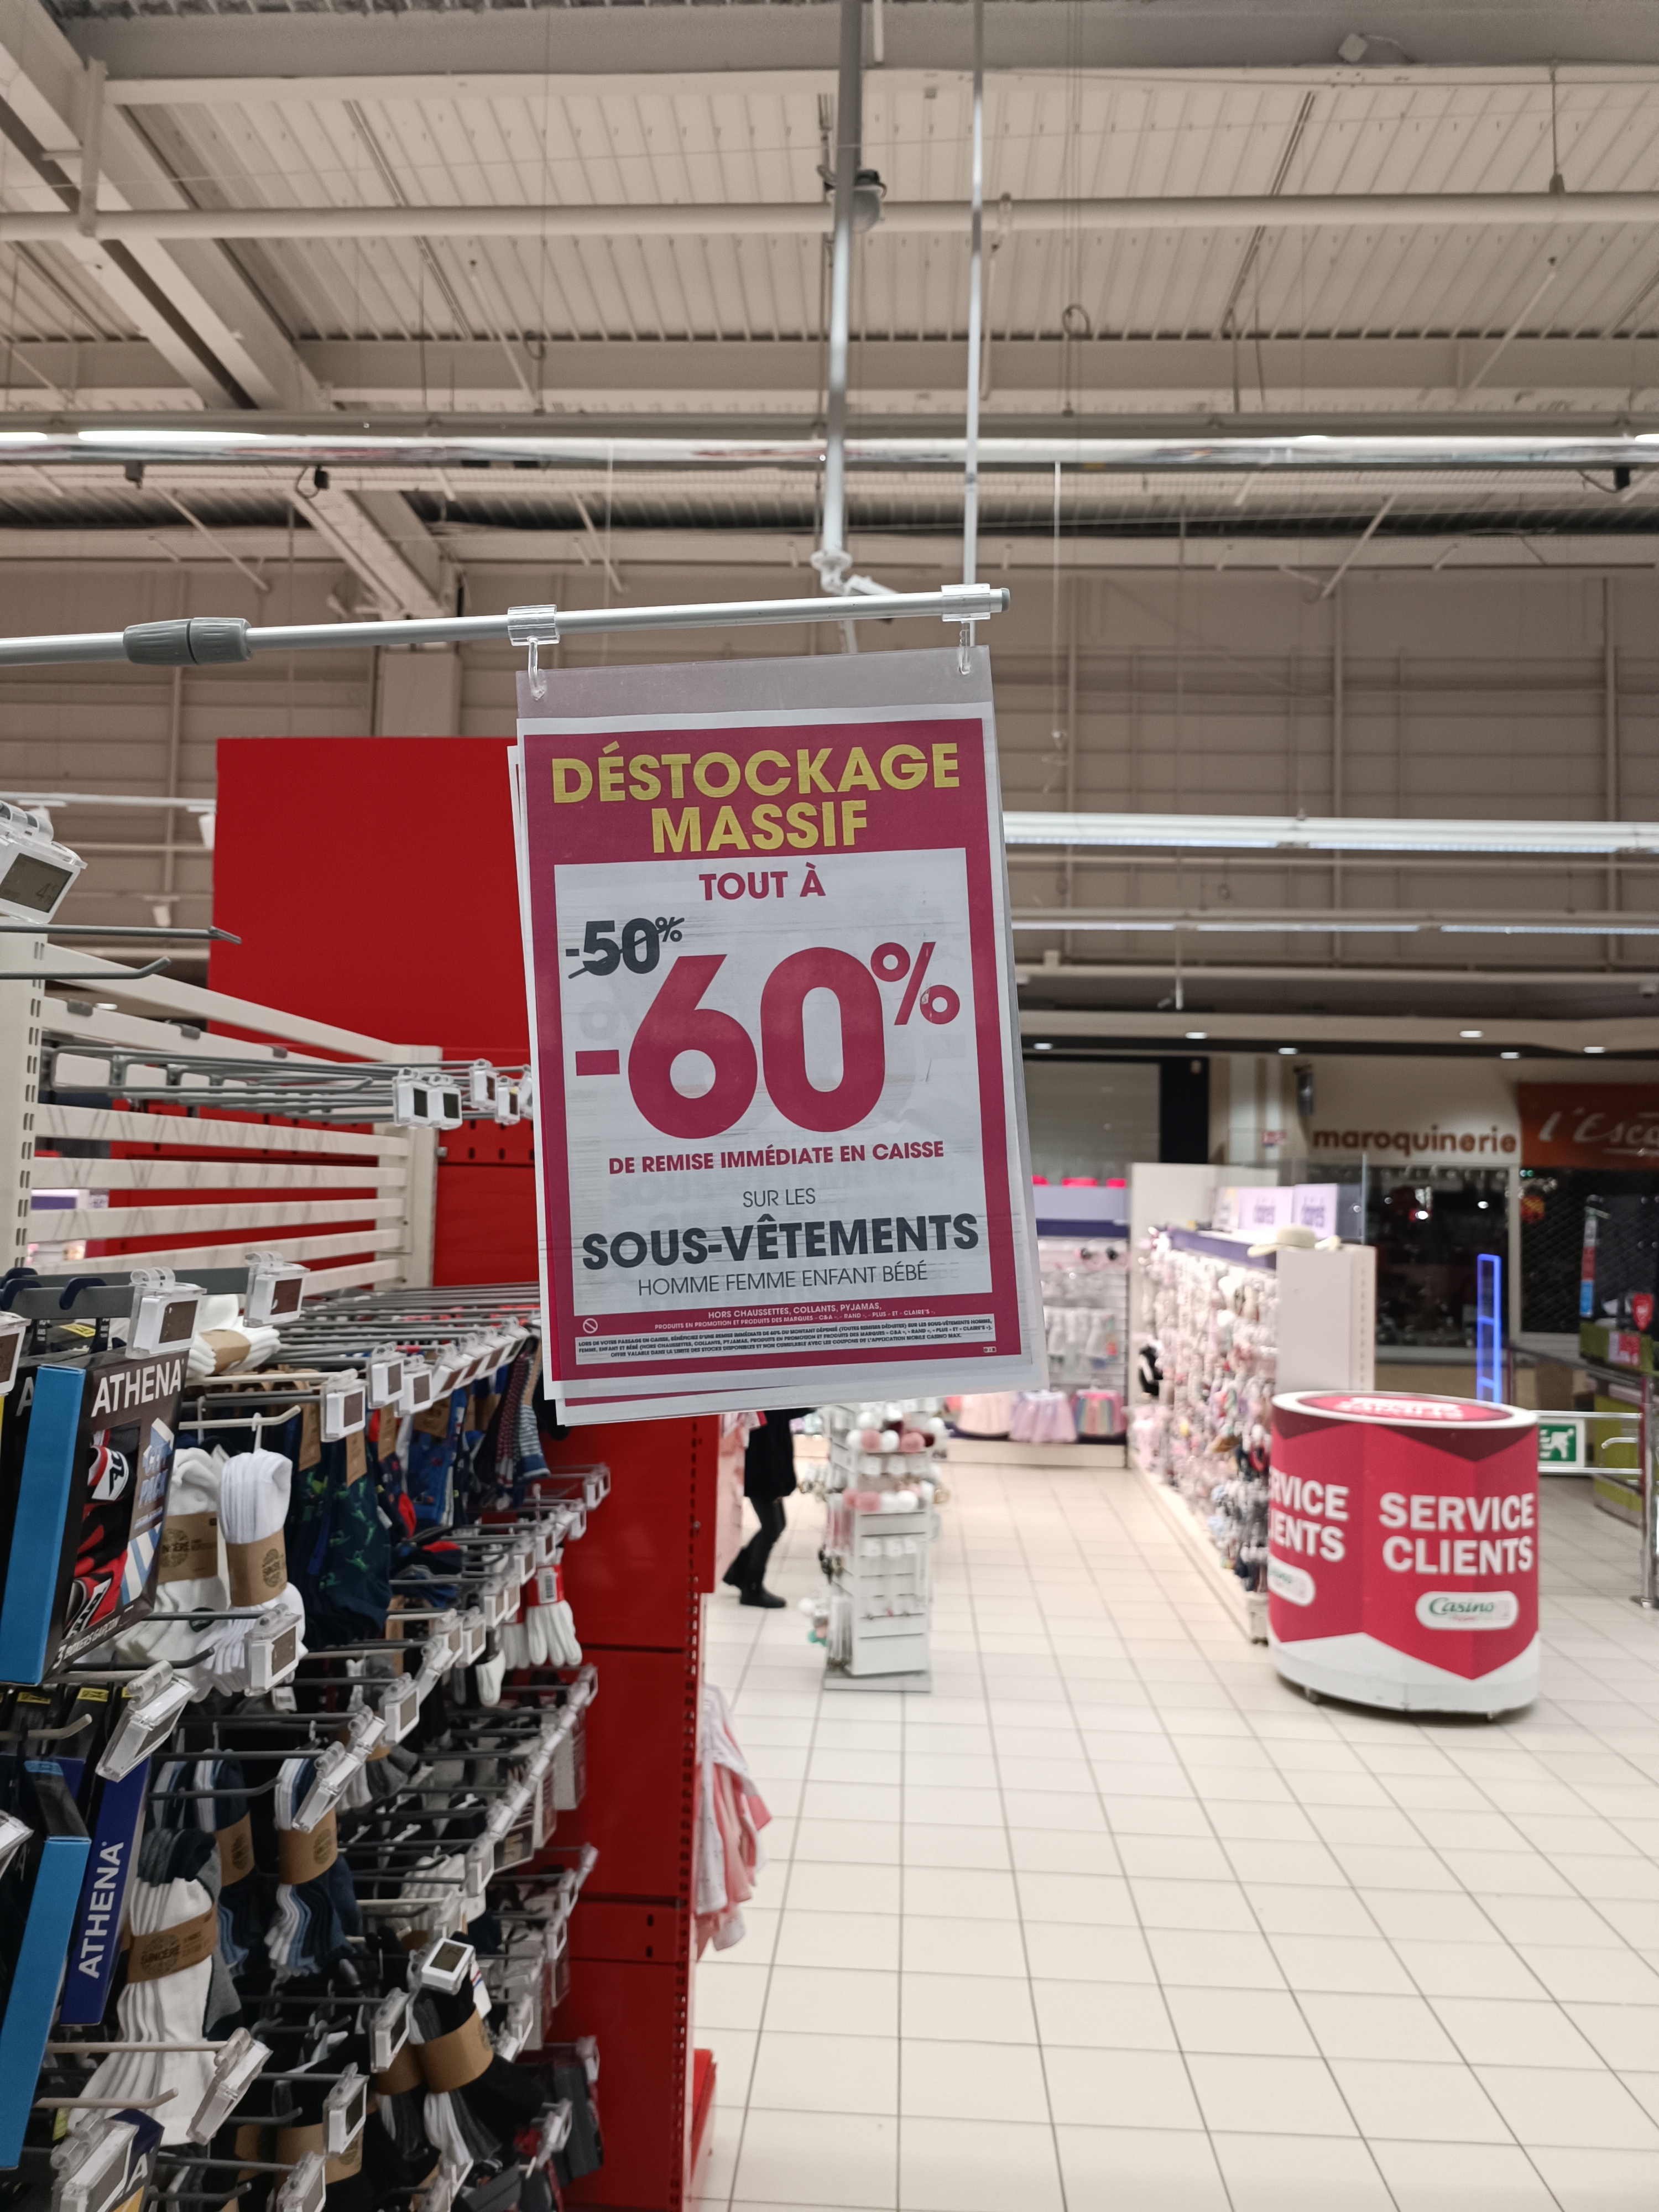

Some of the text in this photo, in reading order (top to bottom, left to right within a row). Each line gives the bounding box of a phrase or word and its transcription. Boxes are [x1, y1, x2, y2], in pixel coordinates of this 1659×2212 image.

[552, 741, 960, 803] DÉSTOCKAGE
[652, 800, 867, 853] MASSIF
[700, 862, 826, 900] TOUT À
[566, 917, 685, 978] -50%
[575, 942, 960, 1139] -60%
[609, 1140, 943, 1175] DE REMISE IMMÉDIATE EN CAISSE
[1313, 1125, 1517, 1156] maroquinerie
[743, 1187, 816, 1208] SUR LES
[582, 1213, 979, 1270] SOUS-VÊTEMENTS
[638, 1262, 928, 1297] HOMME FEMME ENFANT BÉBÉ
[734, 1307, 791, 1318] CHAUSSETTES,
[794, 1305, 838, 1315] COLLANTS,
[841, 1302, 881, 1312] PYJAMAS,
[91, 1359, 181, 1417] ATHENA
[1270, 1465, 1349, 1522] RVICE
[1379, 1492, 1534, 1532] SERVICE
[1383, 1536, 1533, 1575] CLIENTS
[1429, 1597, 1494, 1615] Casino
[79, 1842, 124, 1979] ATHENA
